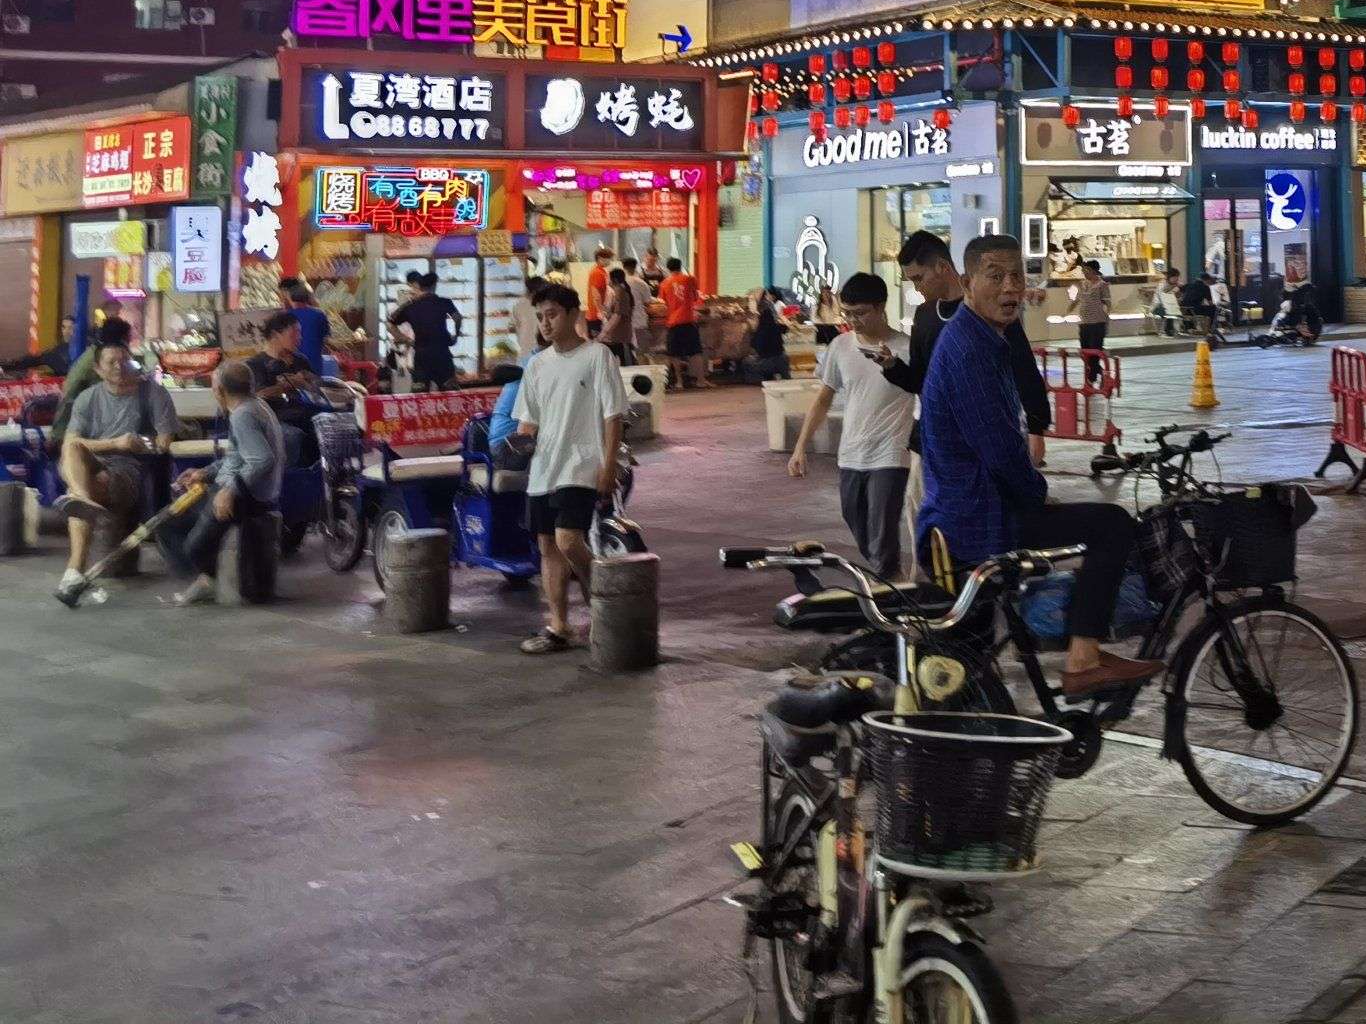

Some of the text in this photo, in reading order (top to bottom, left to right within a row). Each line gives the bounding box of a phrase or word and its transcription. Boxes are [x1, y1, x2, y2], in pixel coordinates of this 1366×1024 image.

[348, 72, 493, 112] 夏湾酒店
[142, 128, 174, 161] 正宗
[1077, 119, 1132, 156] 古茗
[1201, 125, 1257, 149] luckin
[1260, 126, 1315, 150] coffee
[420, 168, 450, 180] BBQ
